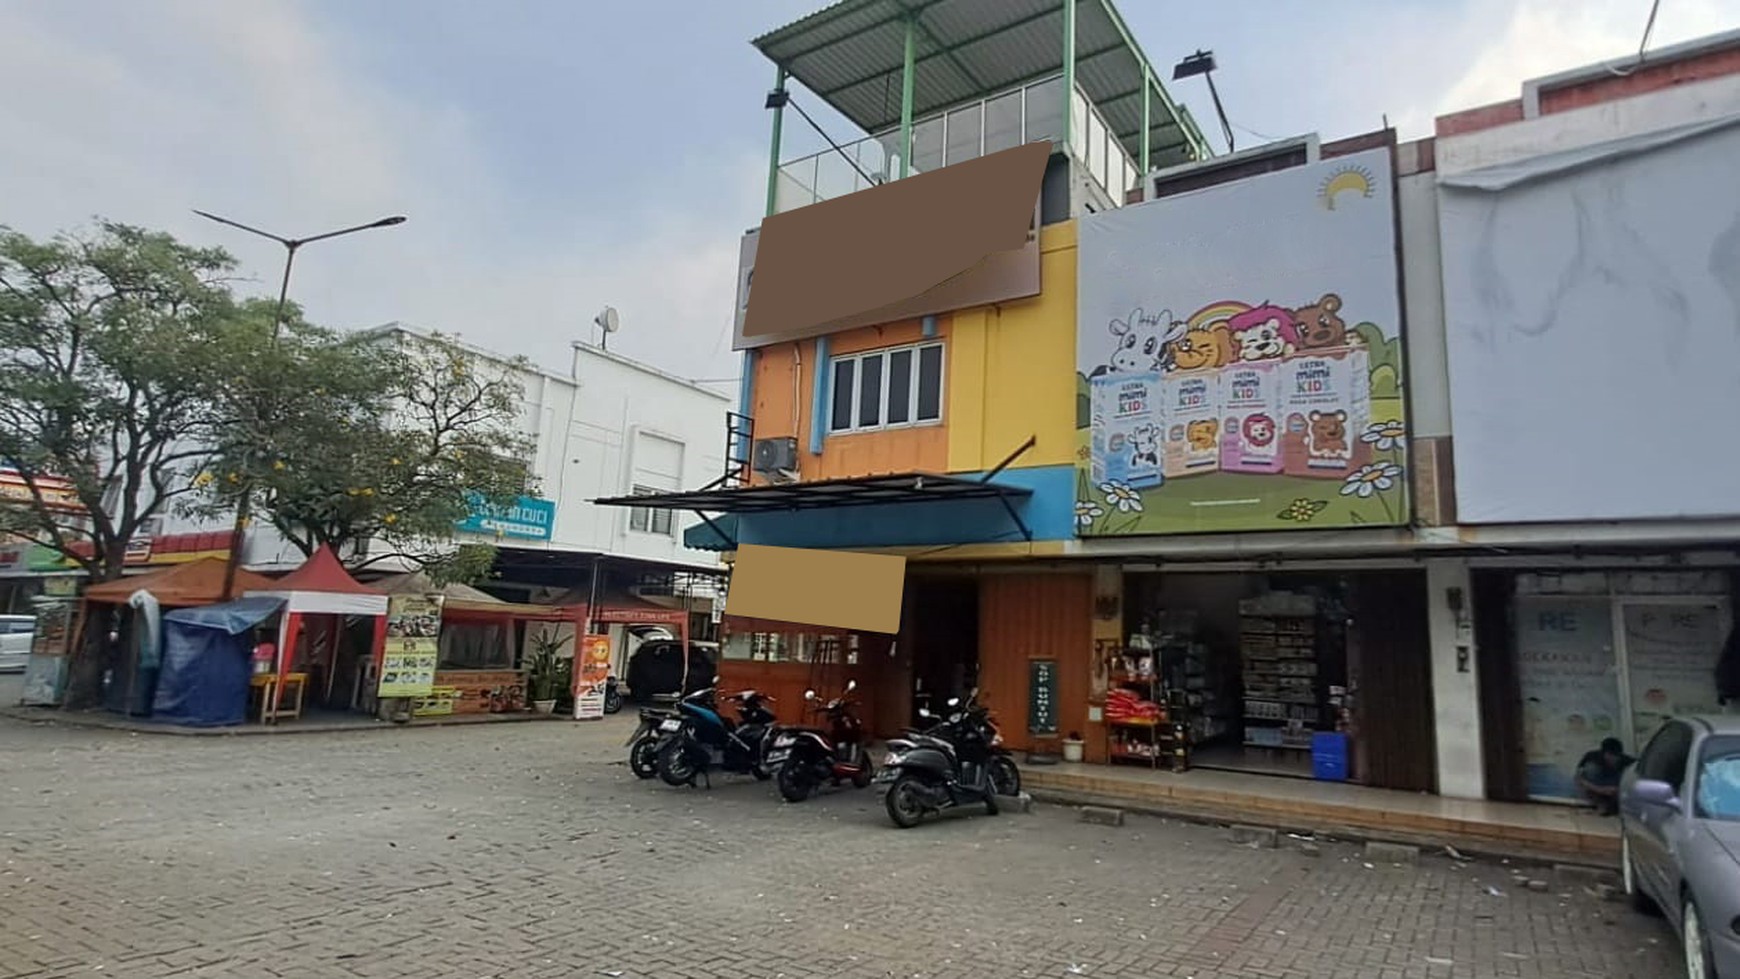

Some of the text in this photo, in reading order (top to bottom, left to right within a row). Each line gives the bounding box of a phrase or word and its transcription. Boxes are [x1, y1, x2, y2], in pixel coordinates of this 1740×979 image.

[1296, 363, 1331, 381] mimi
[1179, 384, 1207, 396] mimi
[1232, 377, 1261, 388] mimi
[1118, 387, 1148, 402] mimi
[1539, 611, 1577, 631] RE
